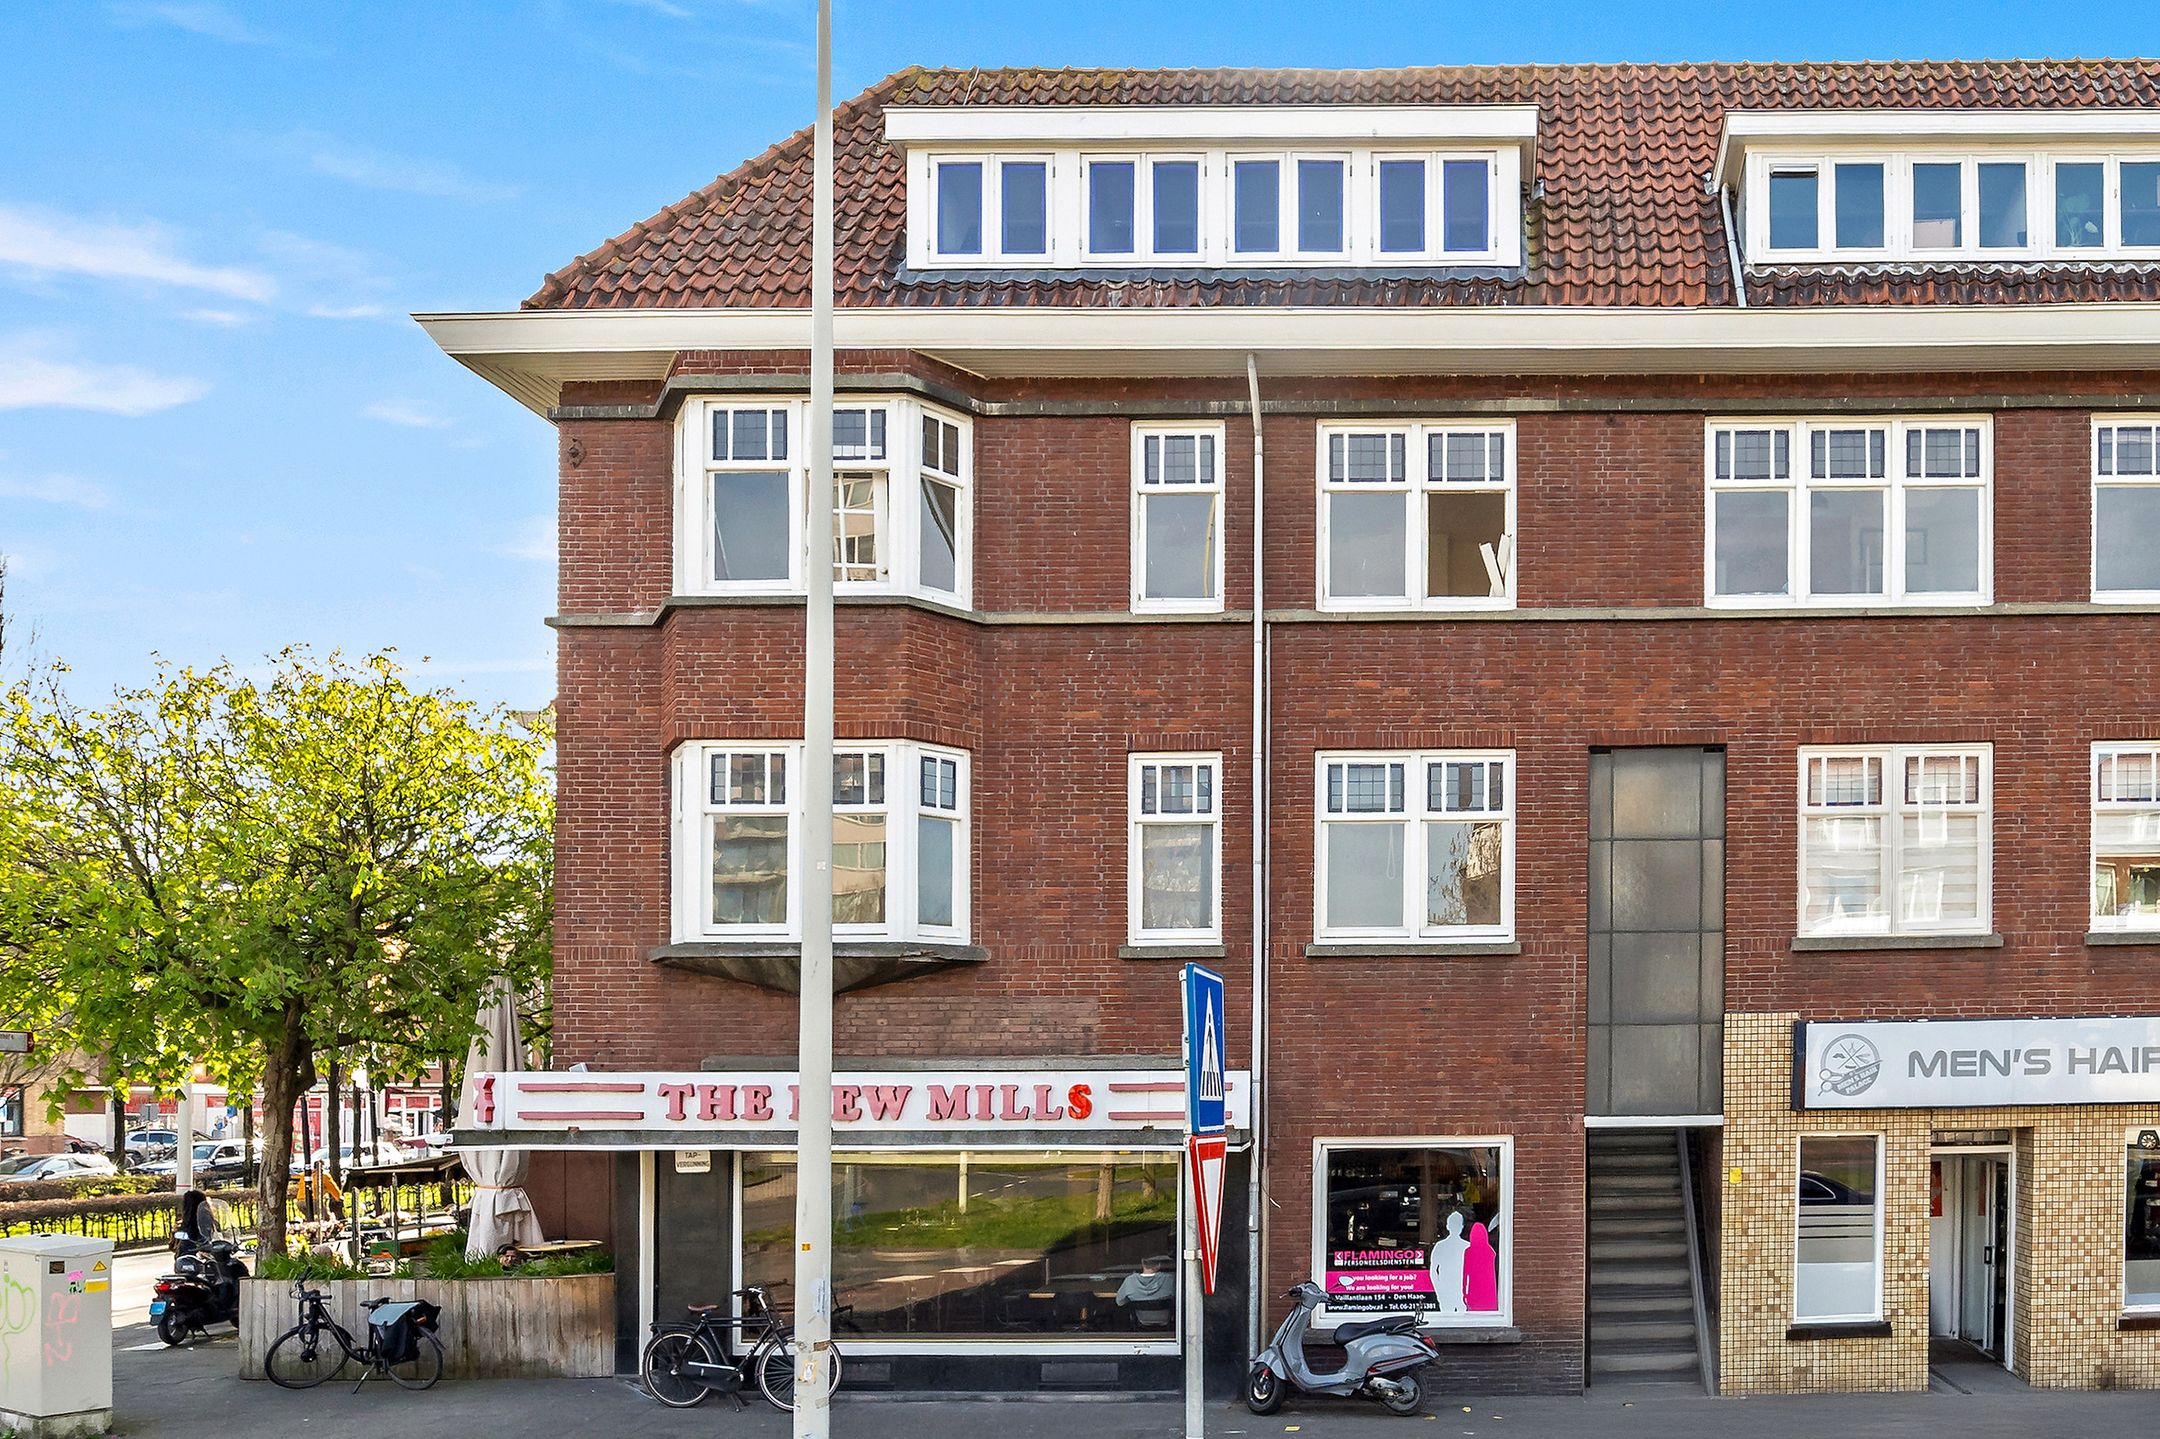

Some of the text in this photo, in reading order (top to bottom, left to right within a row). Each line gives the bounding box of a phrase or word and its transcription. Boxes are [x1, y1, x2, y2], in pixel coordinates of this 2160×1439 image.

[1908, 1048, 2052, 1078] MEN'S
[1845, 1077, 1872, 1094] PALACE
[657, 1083, 774, 1121] THE
[926, 1083, 1093, 1121] MILLS
[676, 1160, 710, 1168] VERGUNNING
[1344, 1250, 1415, 1260] FLAMINGO
[1365, 1274, 1388, 1282] looking
[1389, 1273, 1398, 1281] for
[1403, 1273, 1416, 1282] job?
[1366, 1284, 1390, 1292] looking
[1400, 1284, 1414, 1292] you!
[1335, 1293, 1373, 1301] Vaillantlaan
[1393, 1293, 1407, 1301] Den
